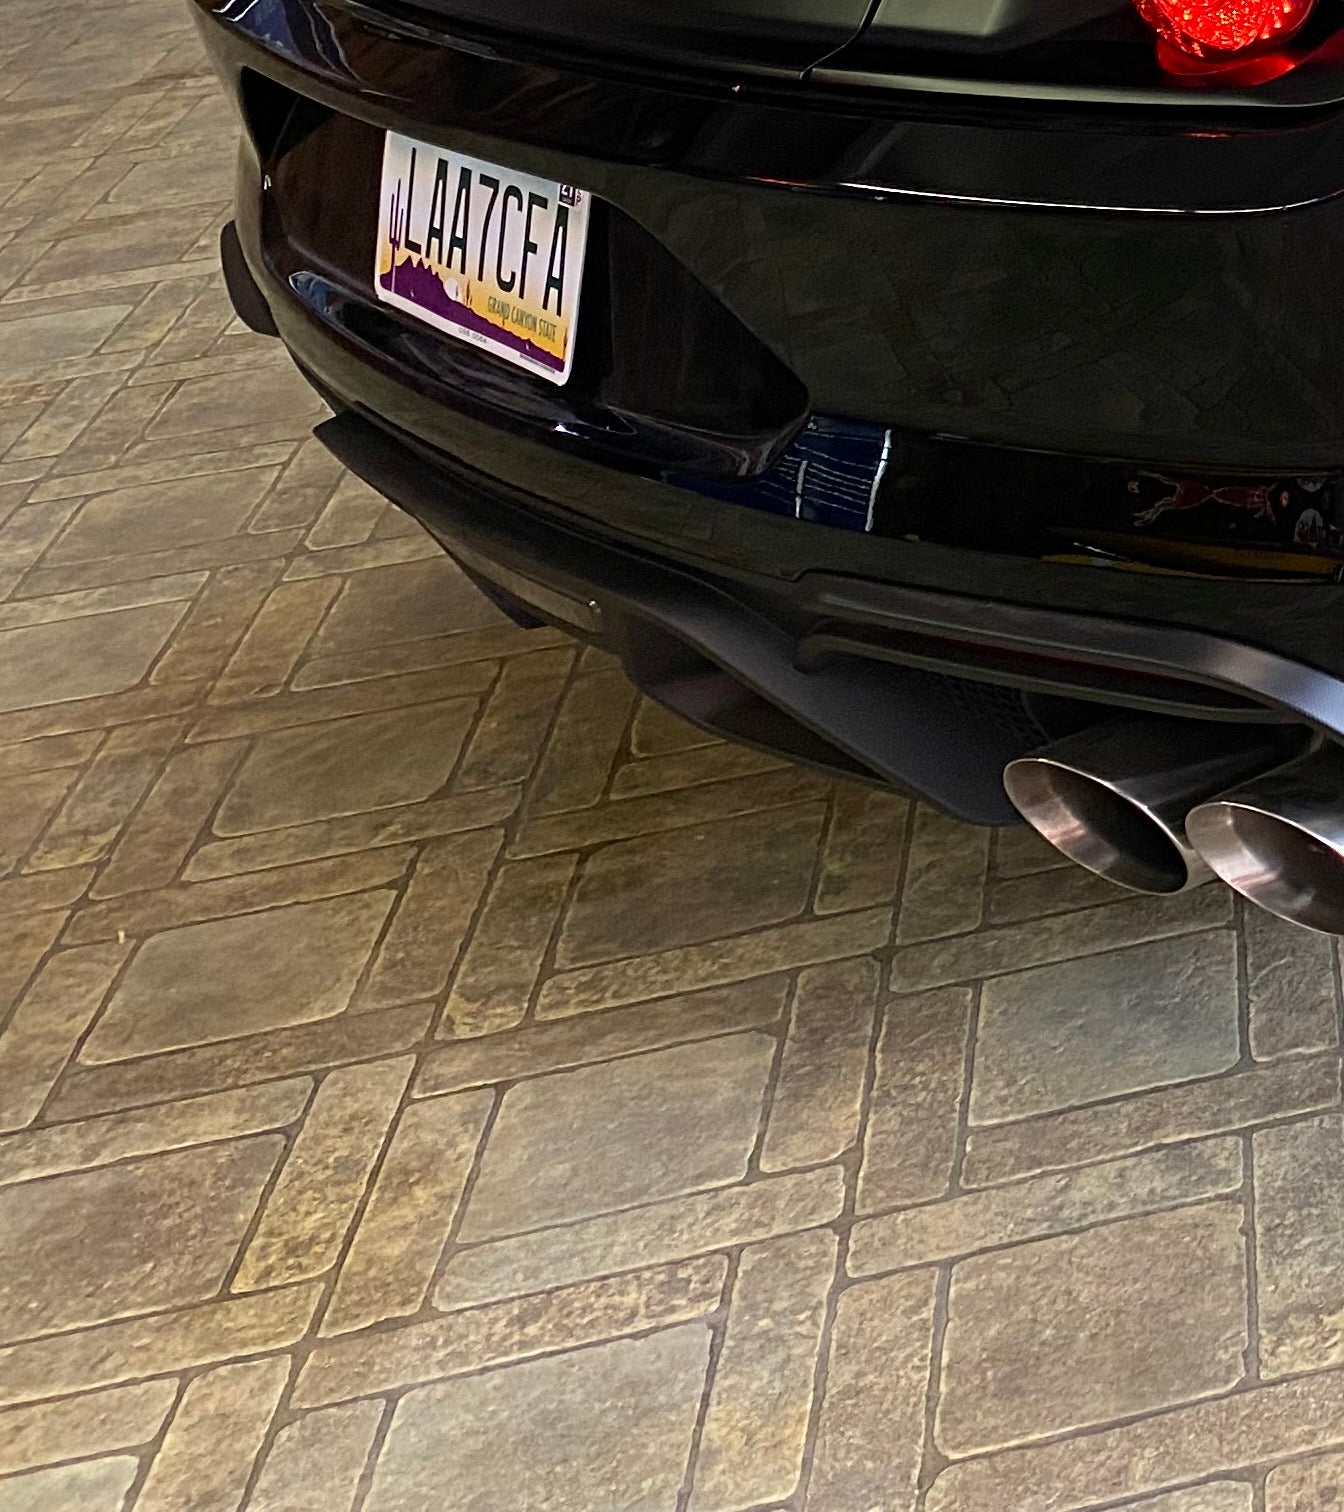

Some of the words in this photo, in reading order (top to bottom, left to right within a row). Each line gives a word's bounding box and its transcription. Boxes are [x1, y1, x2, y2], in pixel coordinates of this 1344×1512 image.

[405, 147, 570, 318] LAA7CFA
[487, 294, 510, 321] GRAND
[511, 305, 538, 334] CANYON
[538, 318, 558, 344] STATE
